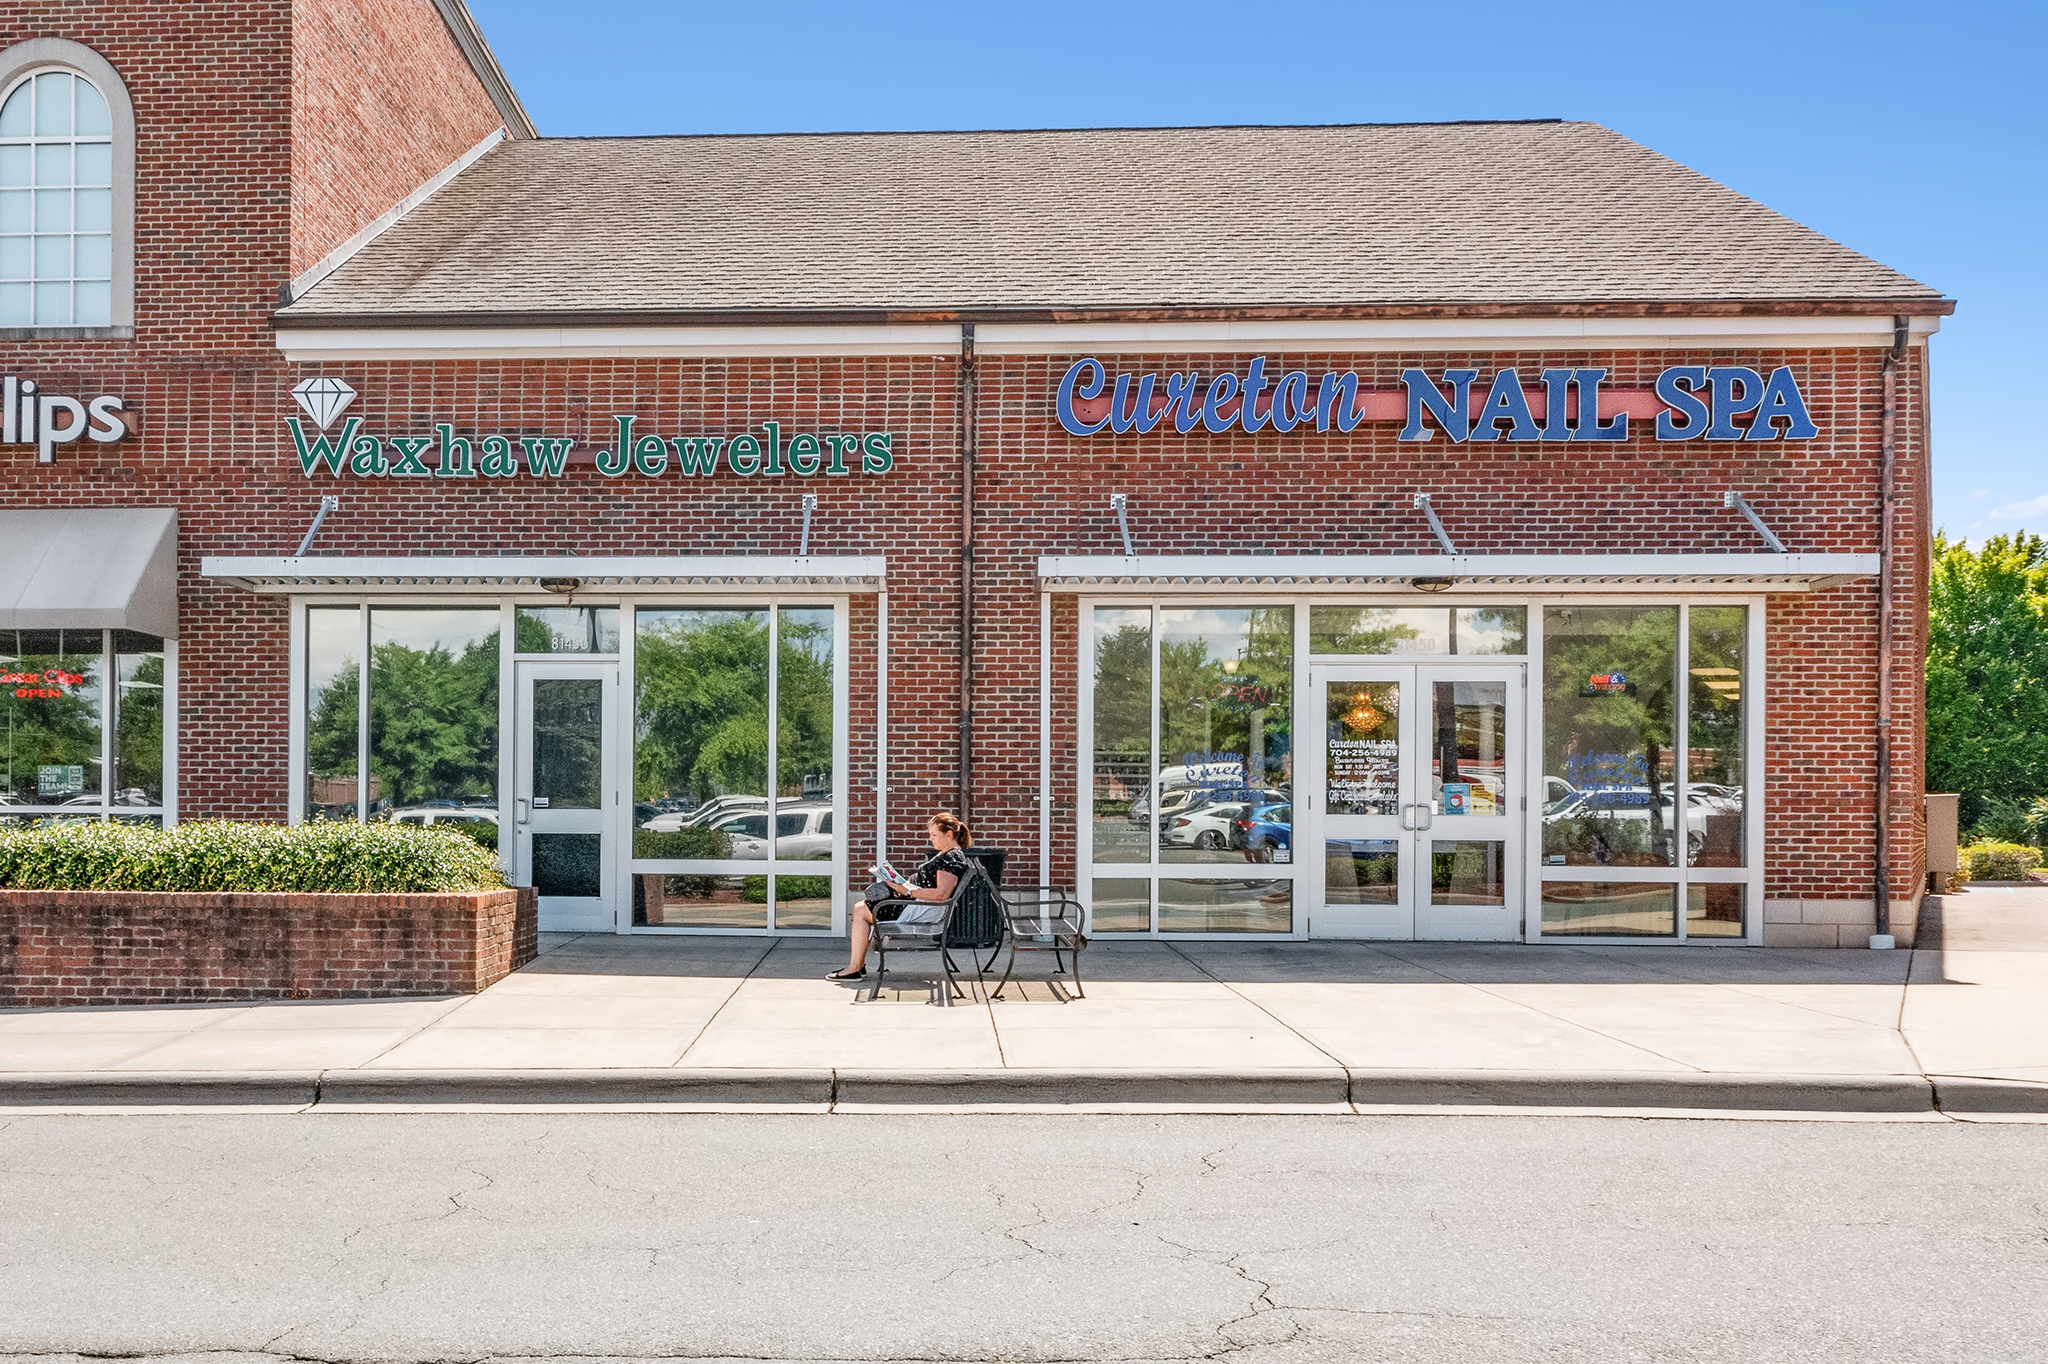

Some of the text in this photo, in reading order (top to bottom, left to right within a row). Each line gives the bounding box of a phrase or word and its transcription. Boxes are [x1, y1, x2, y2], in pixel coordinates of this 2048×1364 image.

[1055, 356, 1820, 443] Cureton NAIL SPA
[0, 375, 126, 463] lips
[283, 414, 894, 479] Waxhaw Jewelers
[44, 669, 83, 687] Clips
[15, 688, 61, 698] OPEN
[1211, 683, 1269, 702] OPEN
[1360, 739, 1378, 749] NAIL
[1380, 739, 1397, 749] SPA
[40, 767, 62, 775] JOIN
[40, 782, 67, 791] TEAM!
